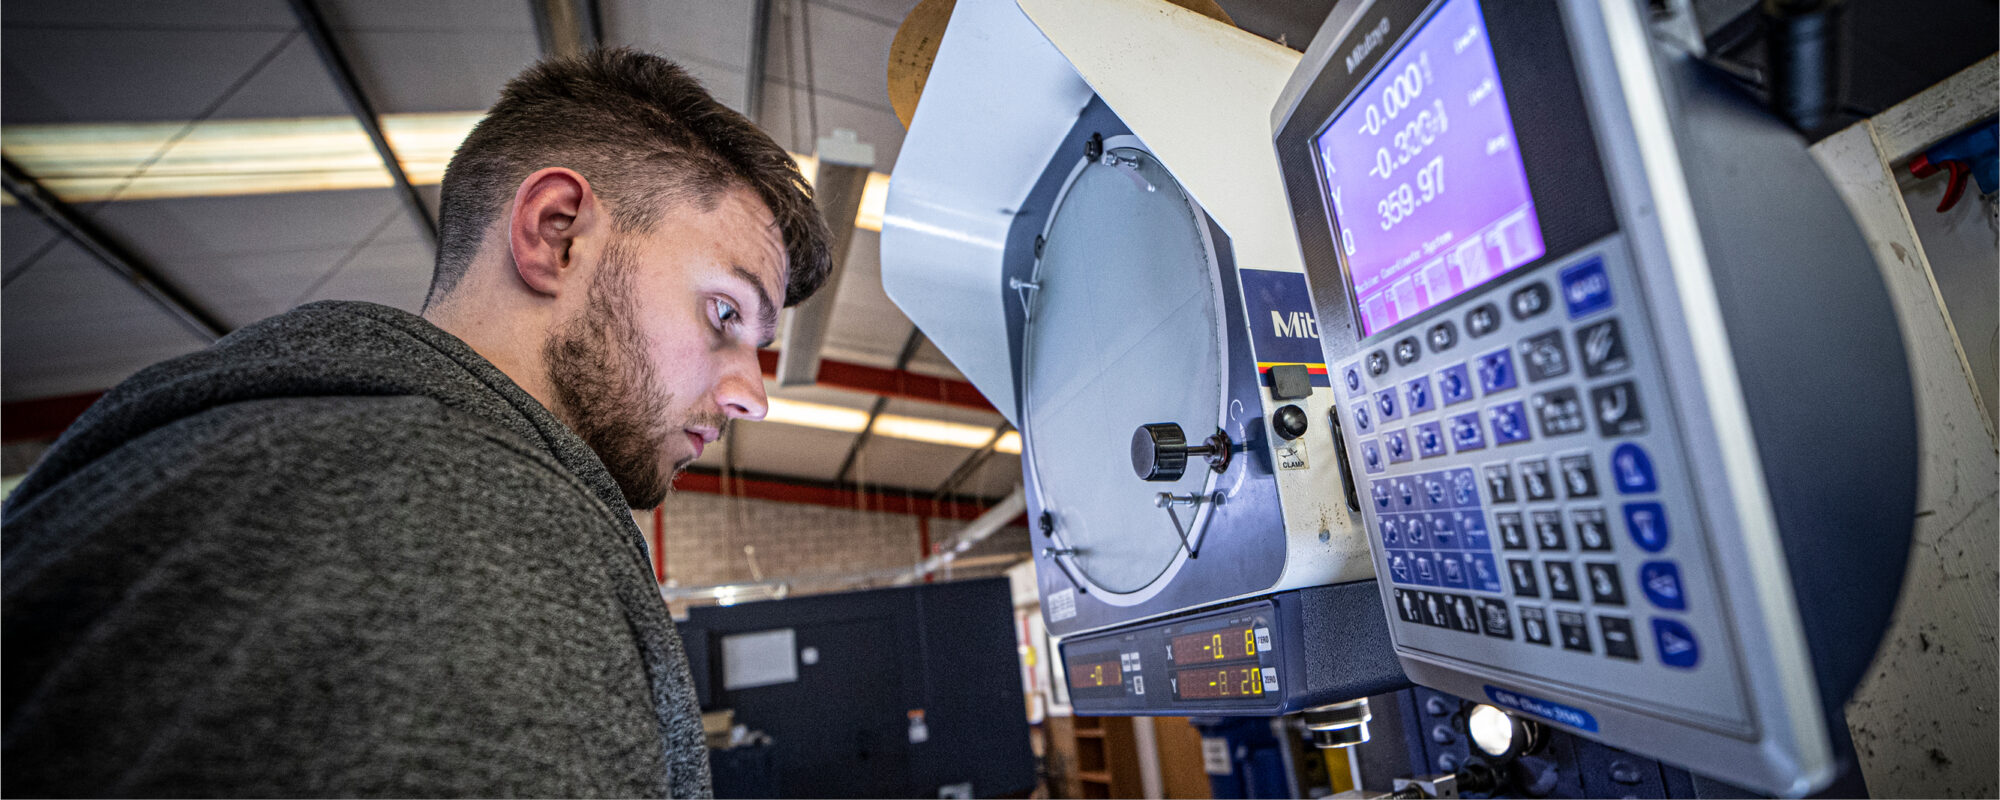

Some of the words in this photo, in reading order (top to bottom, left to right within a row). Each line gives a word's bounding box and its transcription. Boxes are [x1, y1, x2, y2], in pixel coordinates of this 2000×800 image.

[1322, 146, 1336, 178] X
[1331, 186, 1343, 216] Y
[1378, 155, 1445, 231] 359.97
[1282, 461, 1305, 469] CLAMP
[1514, 563, 1528, 588] 1
[1552, 566, 1569, 591] 2
[1594, 569, 1612, 595] 3
[1166, 645, 1173, 660] X
[1244, 629, 1256, 655] 8
[1171, 678, 1177, 693] Y
[1265, 676, 1276, 684] ZERO
